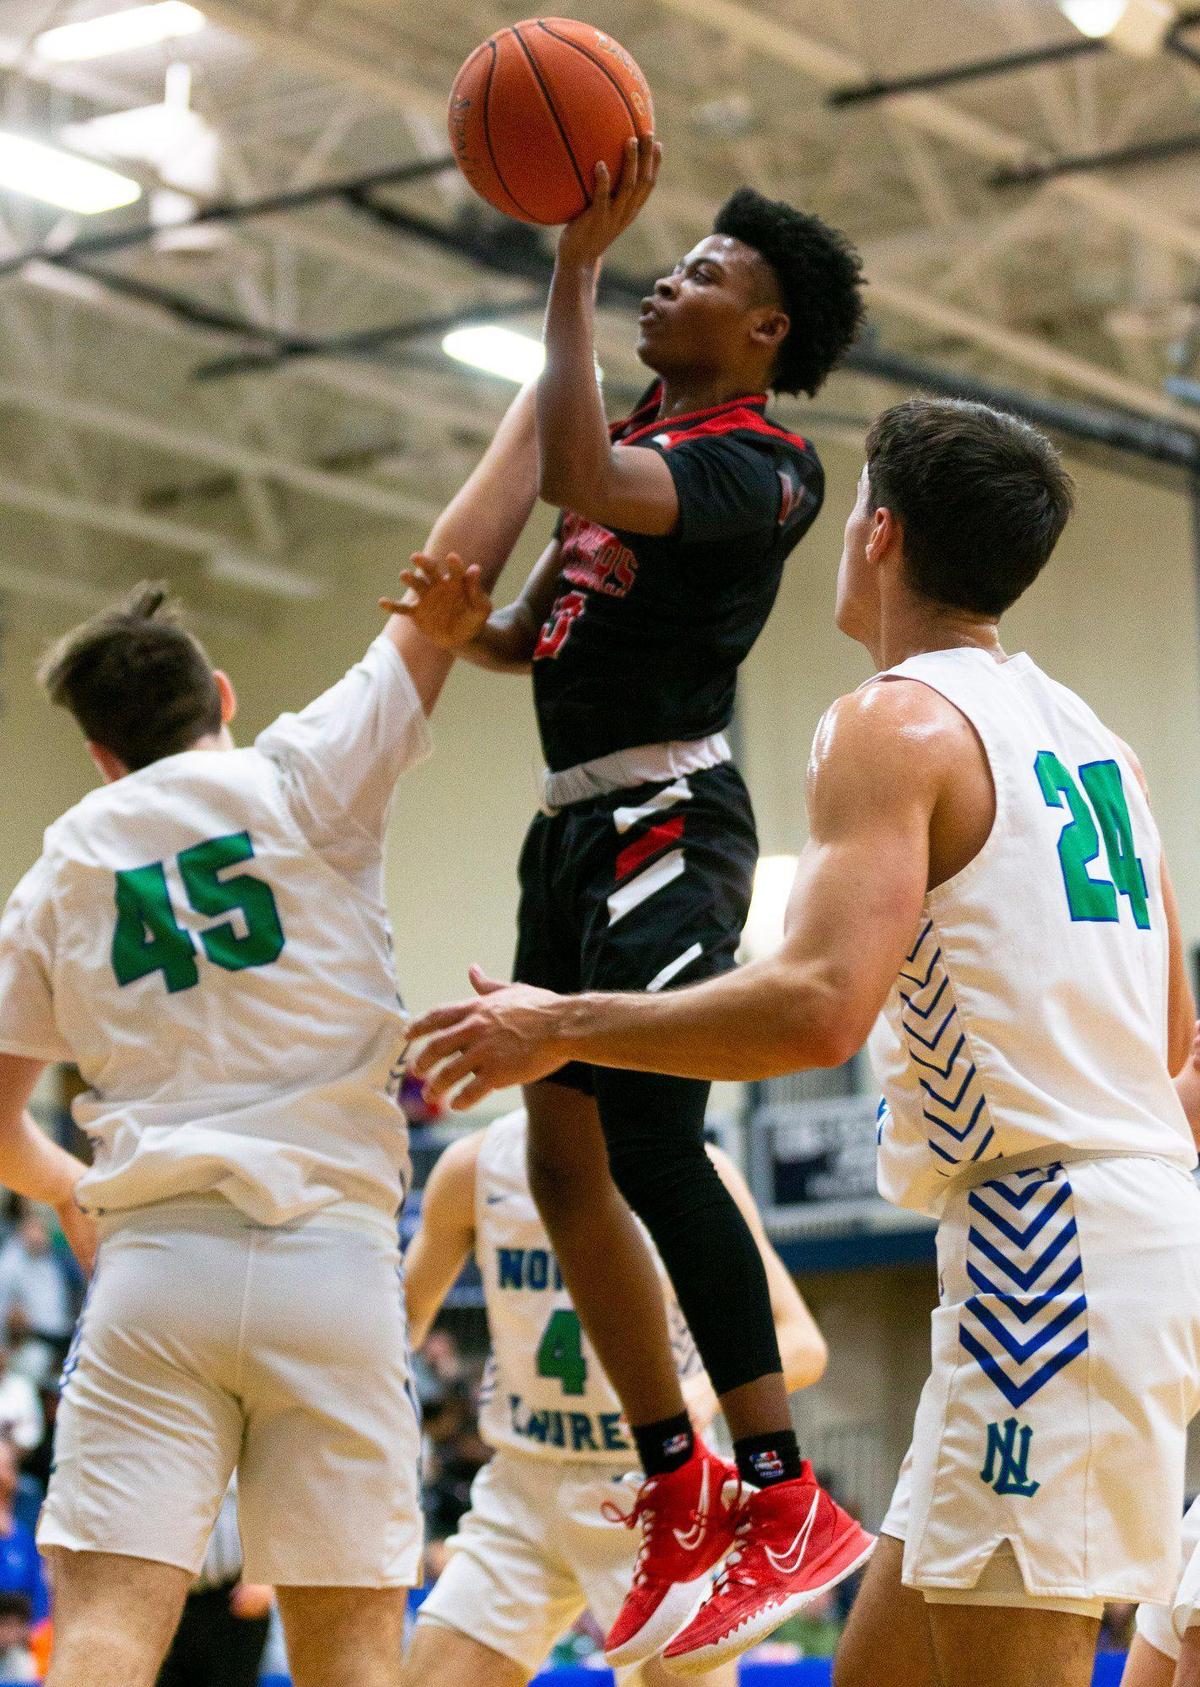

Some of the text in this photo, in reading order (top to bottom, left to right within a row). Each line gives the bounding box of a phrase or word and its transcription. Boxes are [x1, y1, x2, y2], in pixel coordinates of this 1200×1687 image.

[111, 829, 286, 993] 45
[1033, 750, 1151, 930] 24
[536, 1309, 587, 1396] 4
